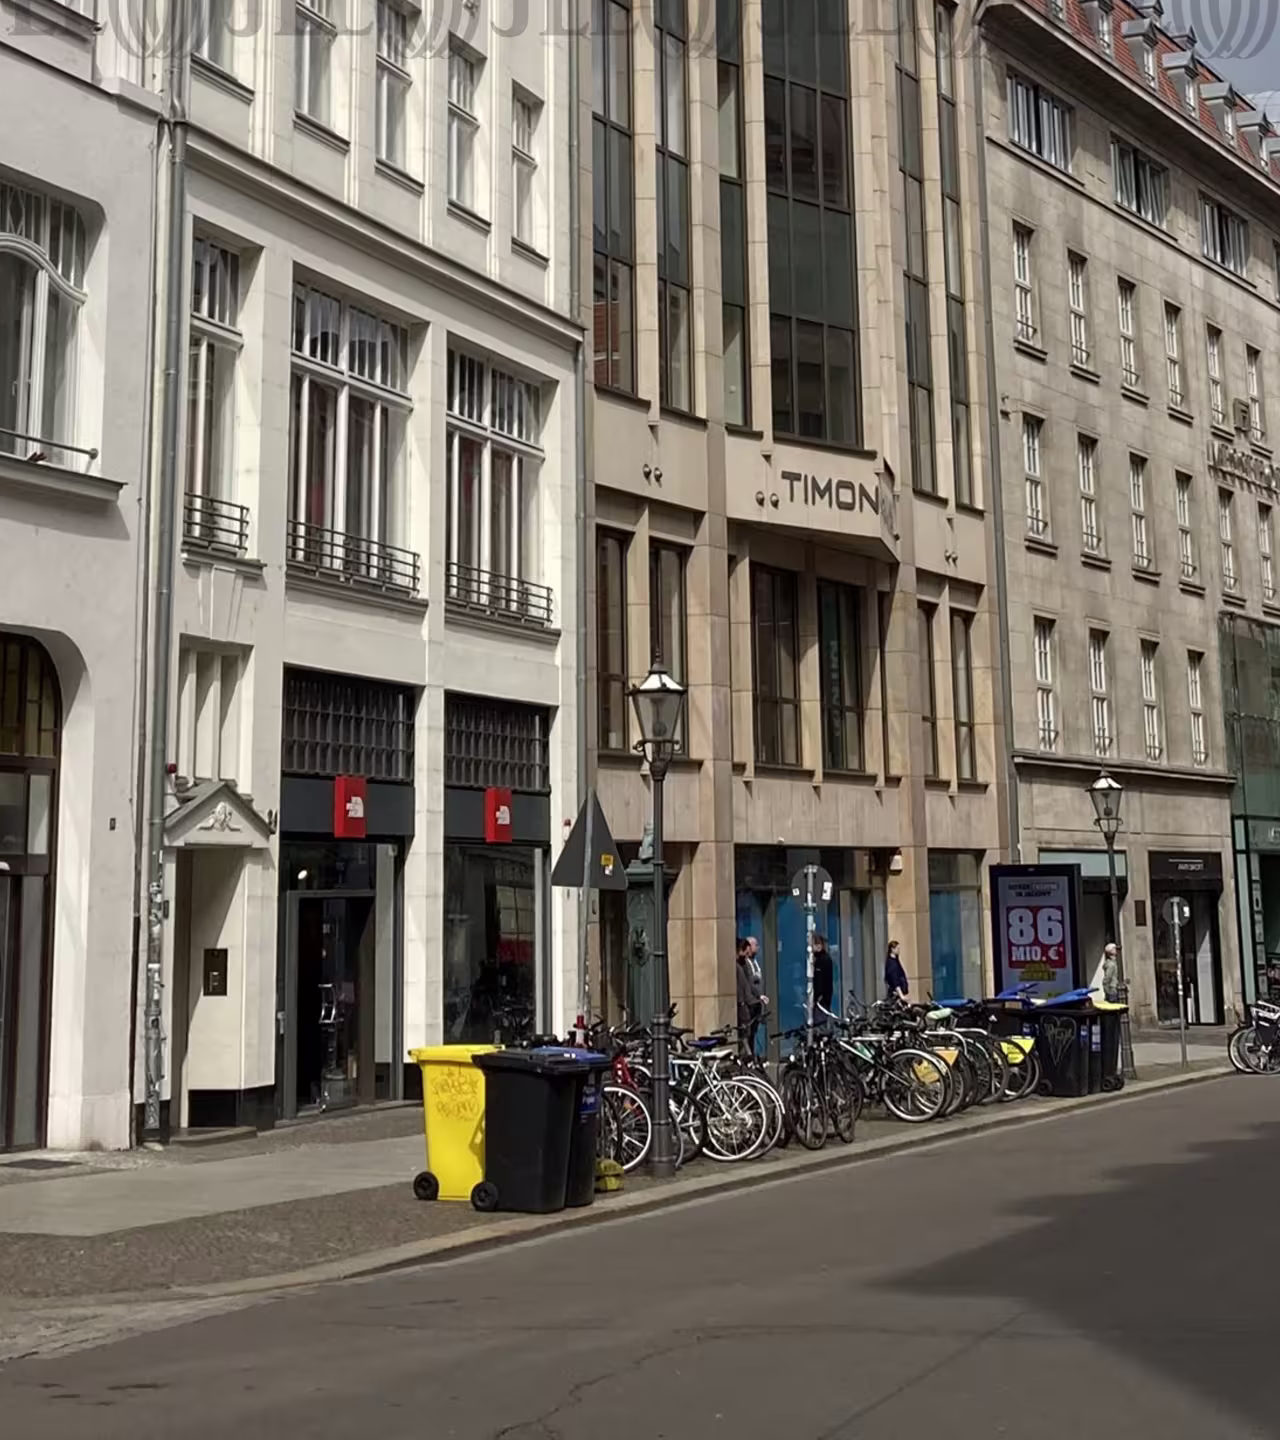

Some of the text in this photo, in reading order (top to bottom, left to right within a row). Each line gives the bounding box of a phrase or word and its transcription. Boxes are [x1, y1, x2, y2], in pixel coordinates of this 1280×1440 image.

[781, 470, 879, 515] TIMON
[1008, 907, 1063, 945] 86
[1011, 946, 1046, 961] MIO.
